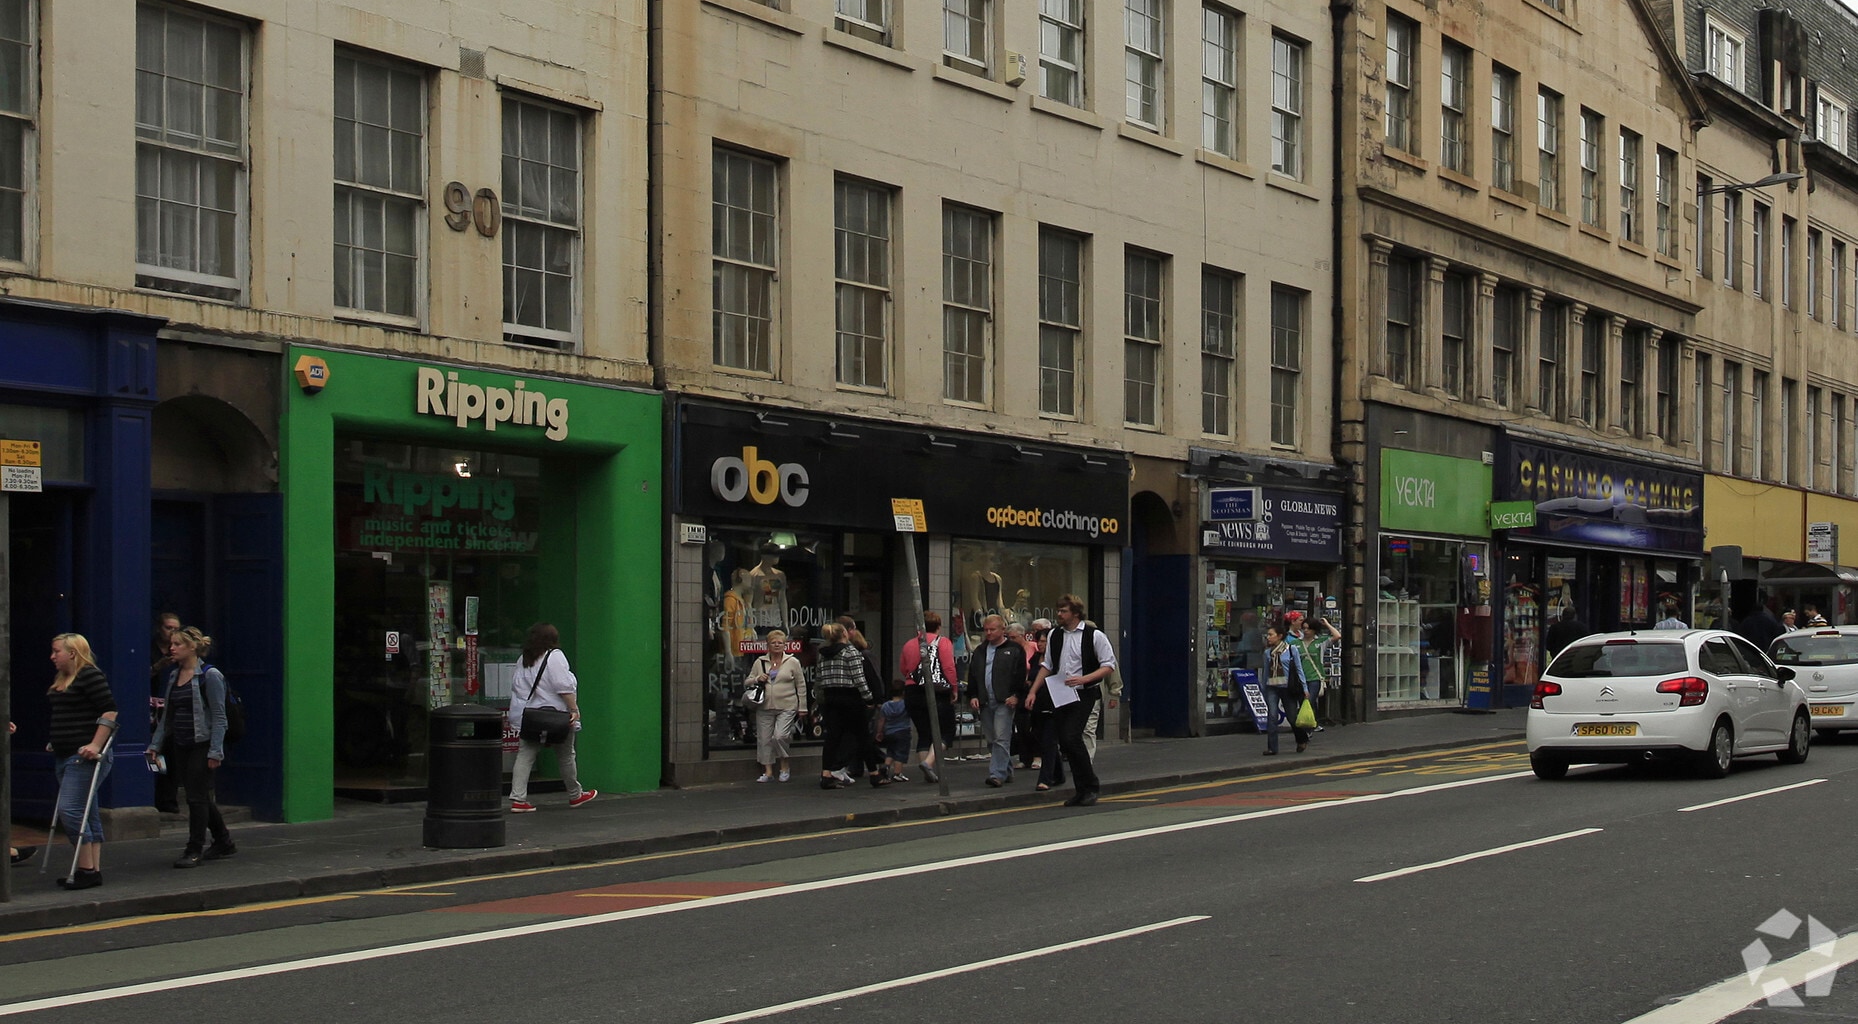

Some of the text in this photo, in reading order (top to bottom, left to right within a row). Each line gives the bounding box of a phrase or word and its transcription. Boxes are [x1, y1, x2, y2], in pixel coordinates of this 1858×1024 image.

[444, 181, 501, 237] 90
[310, 367, 323, 376] ADT
[417, 366, 569, 442] Ripping
[711, 446, 810, 507] obc
[1520, 459, 1693, 511] CASHINO GAMING
[363, 462, 516, 521] Ripping
[1395, 476, 1435, 508] YEKTA
[1280, 499, 1313, 514] GLOBAL
[1314, 503, 1337, 516] NEWS
[1494, 511, 1532, 525] YEKTA
[364, 517, 513, 538] music and tickets
[987, 505, 1118, 538] offbeat clothing co
[359, 530, 460, 551] independent
[1227, 541, 1256, 549] EDINBURGH
[791, 642, 801, 651] GO
[1821, 706, 1840, 714] CKY
[1581, 725, 1608, 735] SP60
